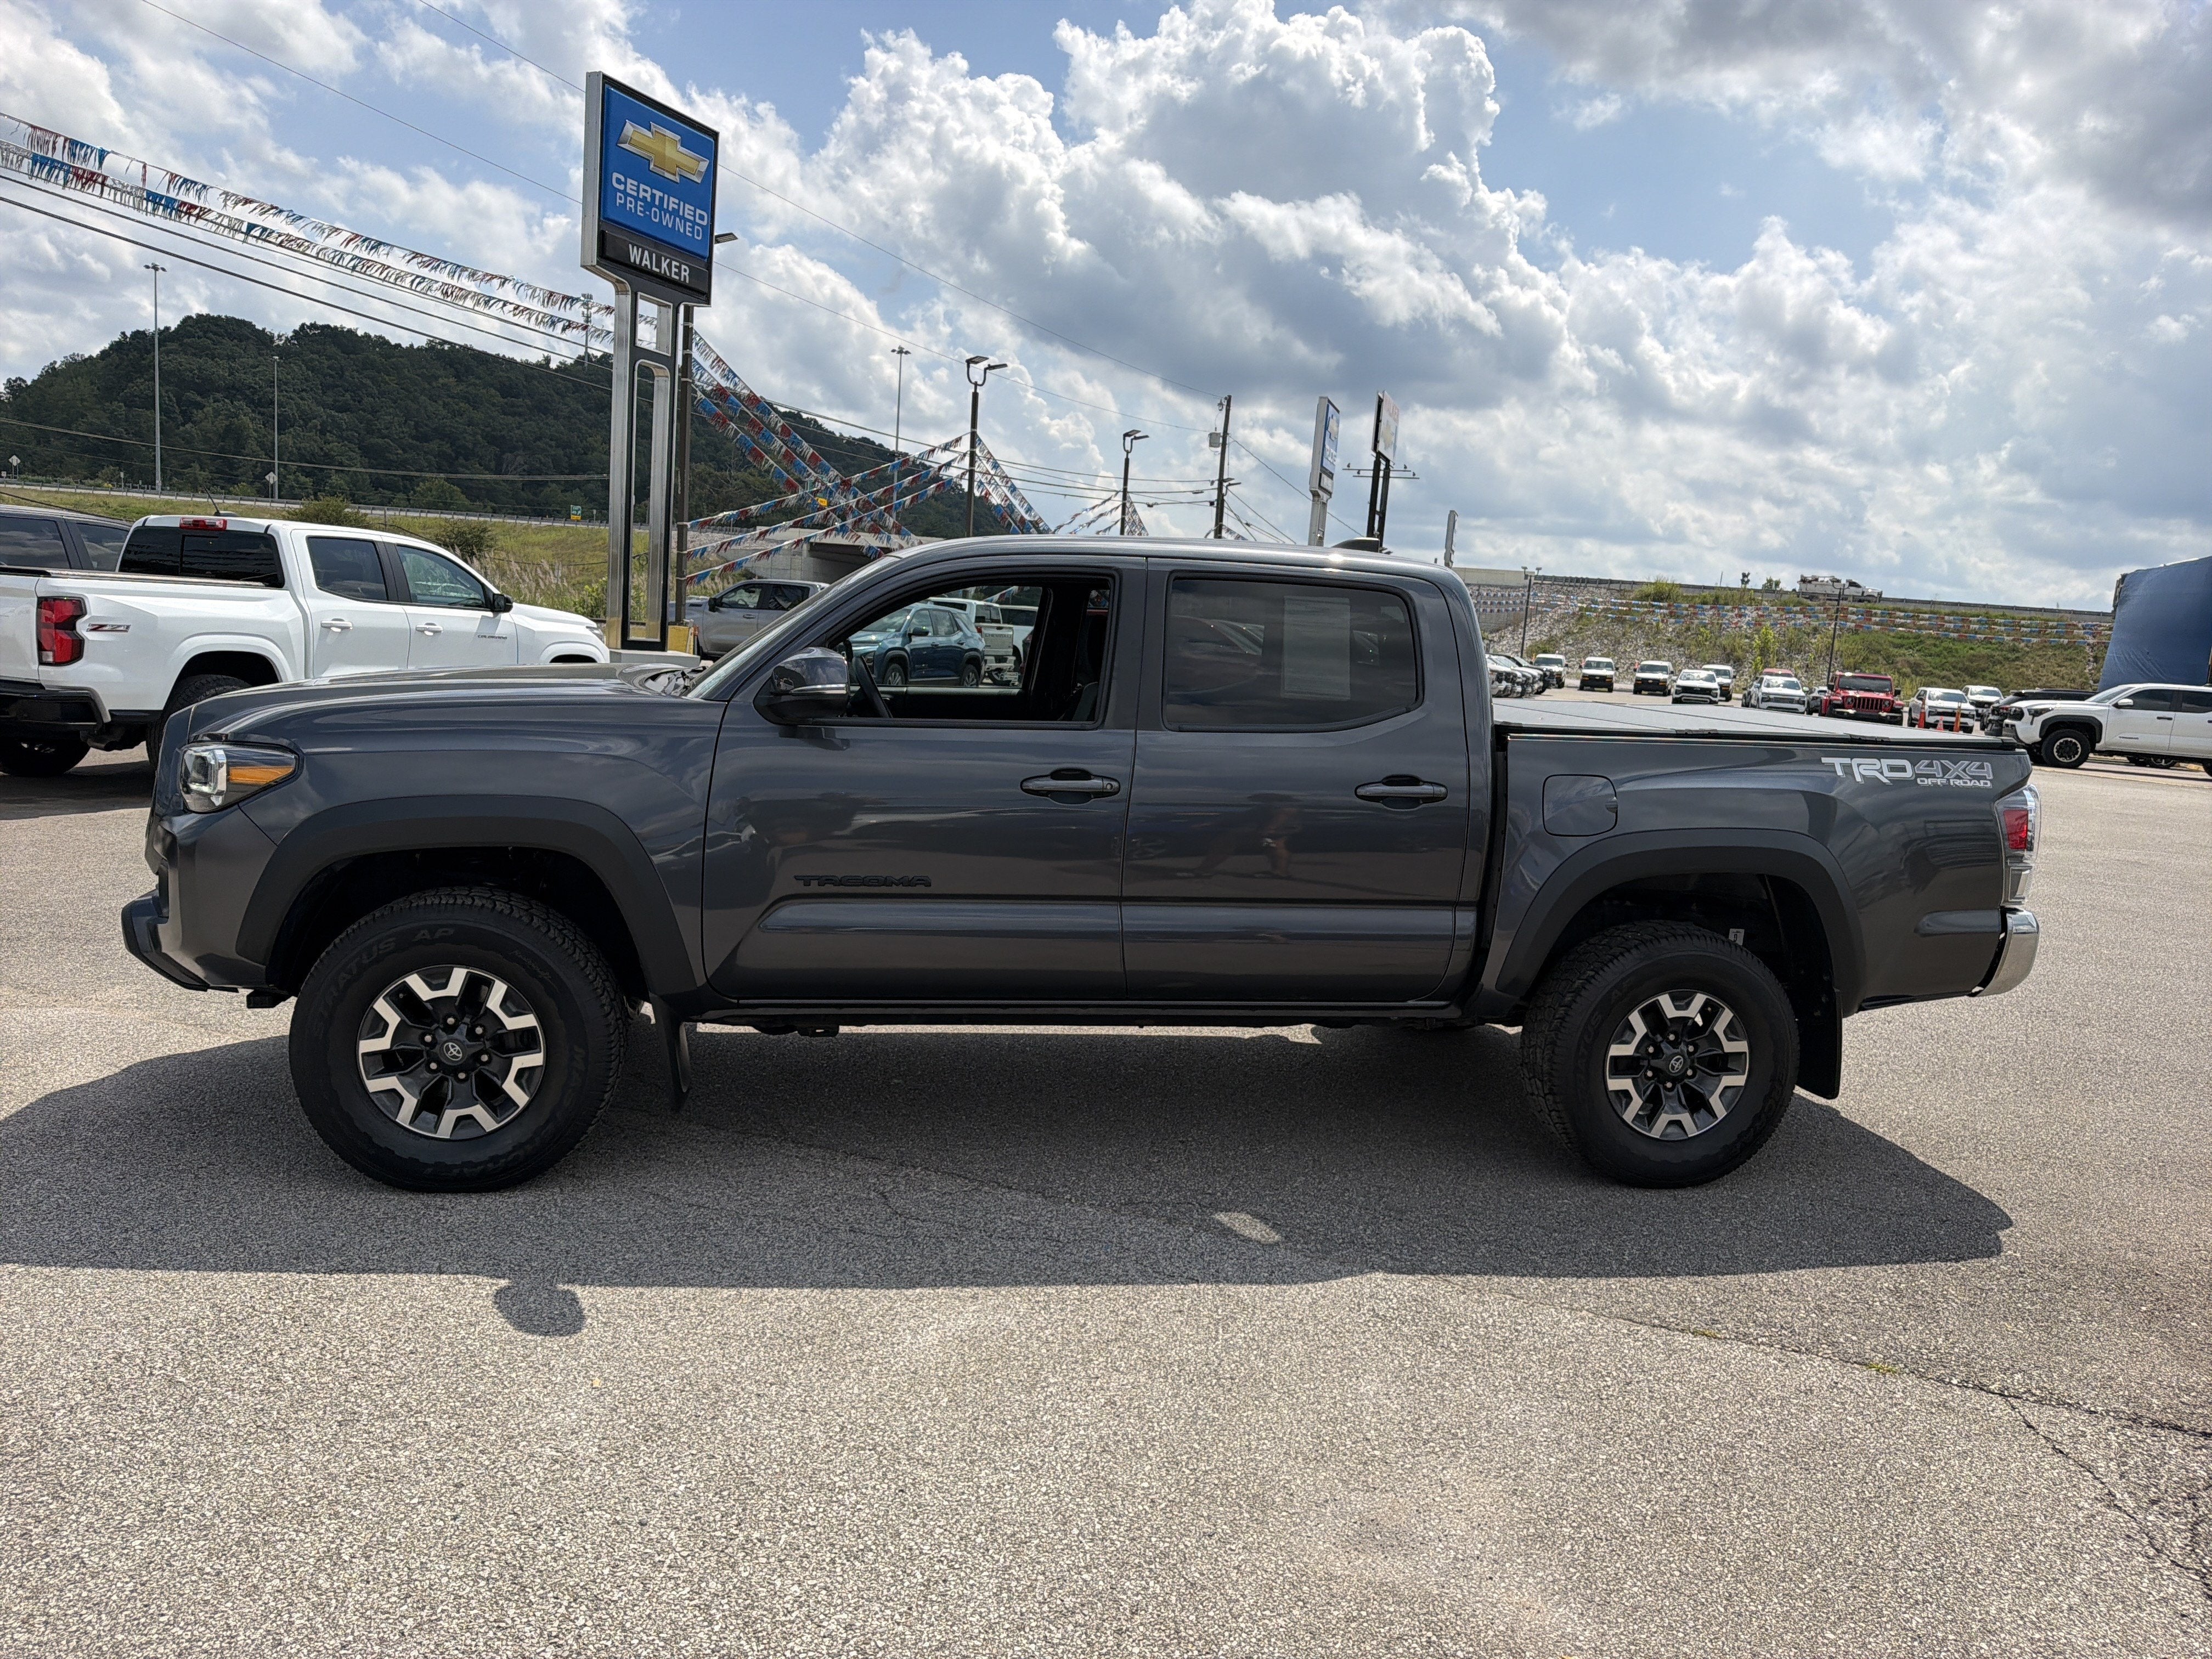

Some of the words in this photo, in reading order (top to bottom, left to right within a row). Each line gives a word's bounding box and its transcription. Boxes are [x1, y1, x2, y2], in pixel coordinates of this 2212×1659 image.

[612, 172, 708, 226] CERTIFIED
[616, 192, 703, 240] PRE-OWNED
[628, 244, 690, 284] WALKER
[1821, 757, 1915, 785] TRD
[1917, 777, 1948, 787] OFF
[1950, 778, 1993, 788] ROAD
[793, 875, 932, 887] TACOMA
[411, 927, 455, 943] AP
